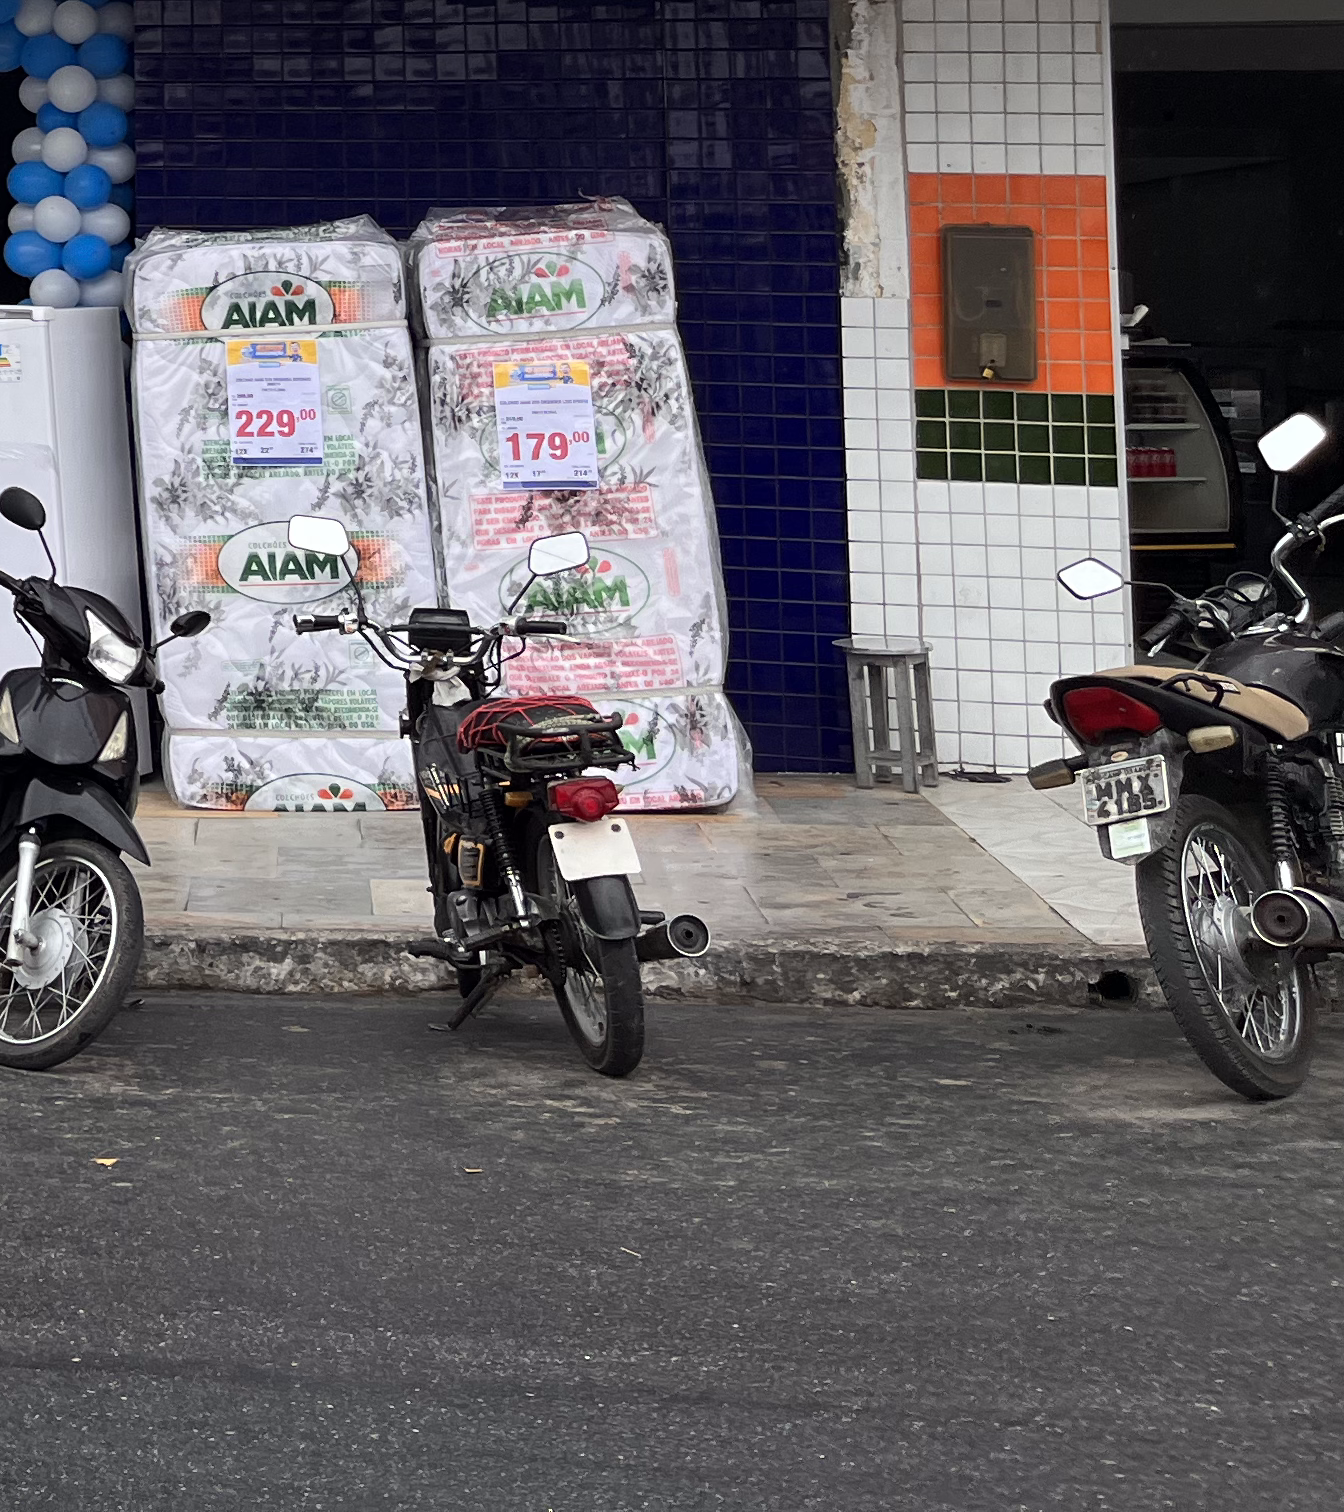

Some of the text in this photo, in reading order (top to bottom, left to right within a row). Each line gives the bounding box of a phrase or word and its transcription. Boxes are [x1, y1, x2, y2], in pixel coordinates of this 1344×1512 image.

[221, 298, 317, 330] AIAM
[235, 408, 317, 438] 229,00
[506, 431, 590, 461] 179,00
[248, 541, 287, 549] COLCHÕES
[238, 550, 340, 582] AIAM
